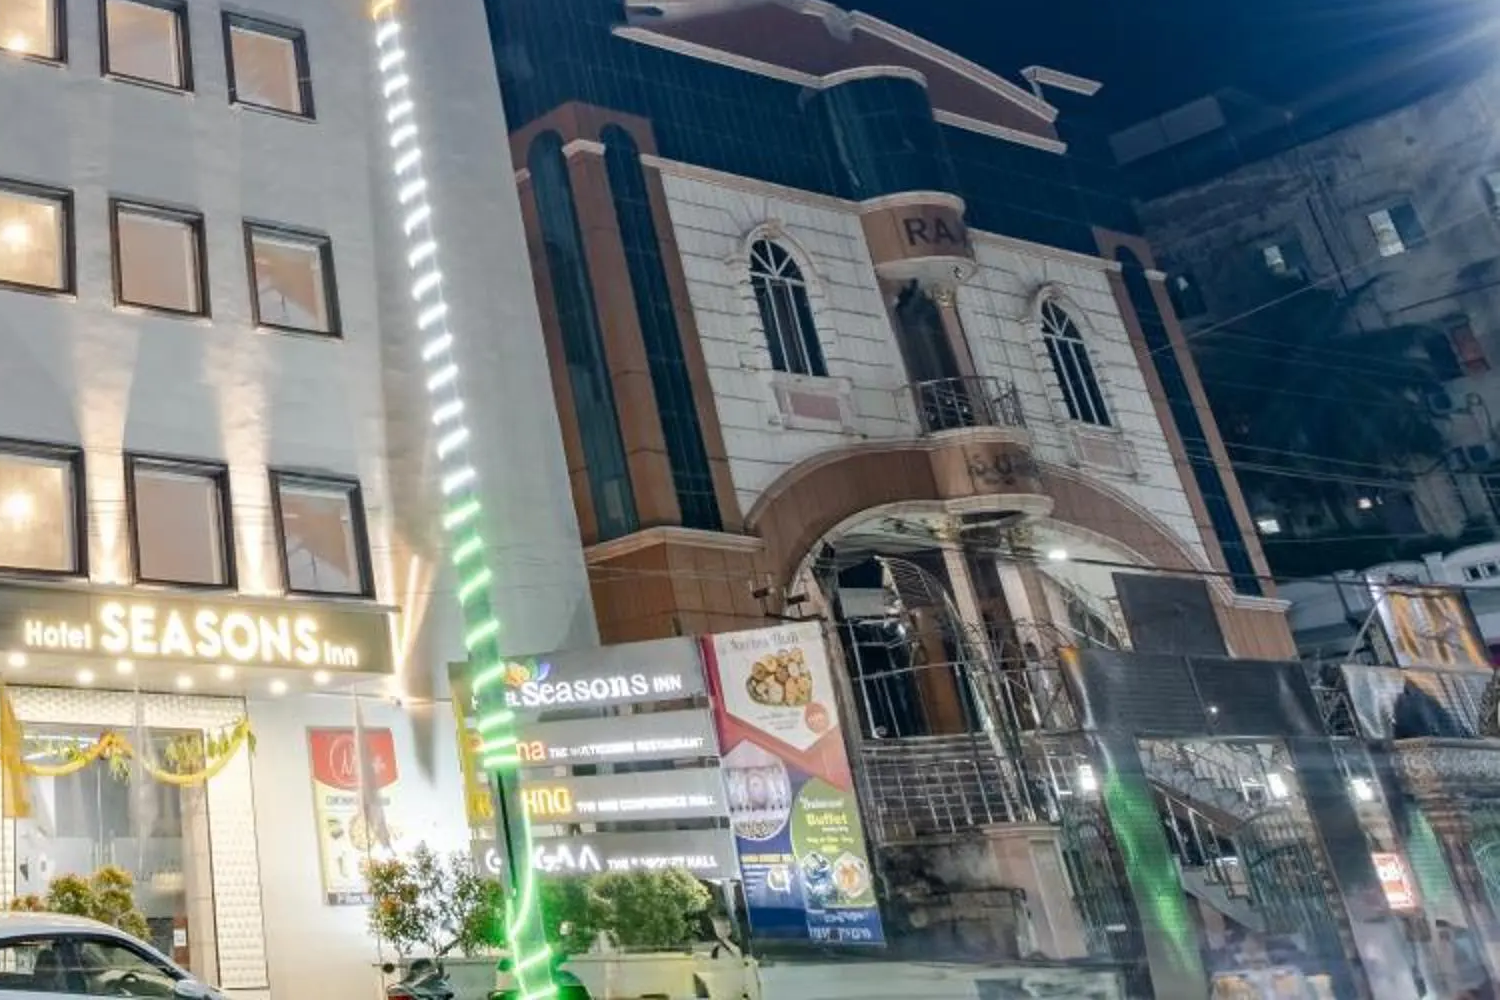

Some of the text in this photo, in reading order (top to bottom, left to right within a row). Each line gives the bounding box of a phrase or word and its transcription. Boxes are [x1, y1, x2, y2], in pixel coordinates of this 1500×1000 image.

[25, 620, 92, 650] Hotel
[100, 601, 321, 664] SEASONS
[652, 674, 683, 694] INN
[687, 855, 718, 868] HALL
